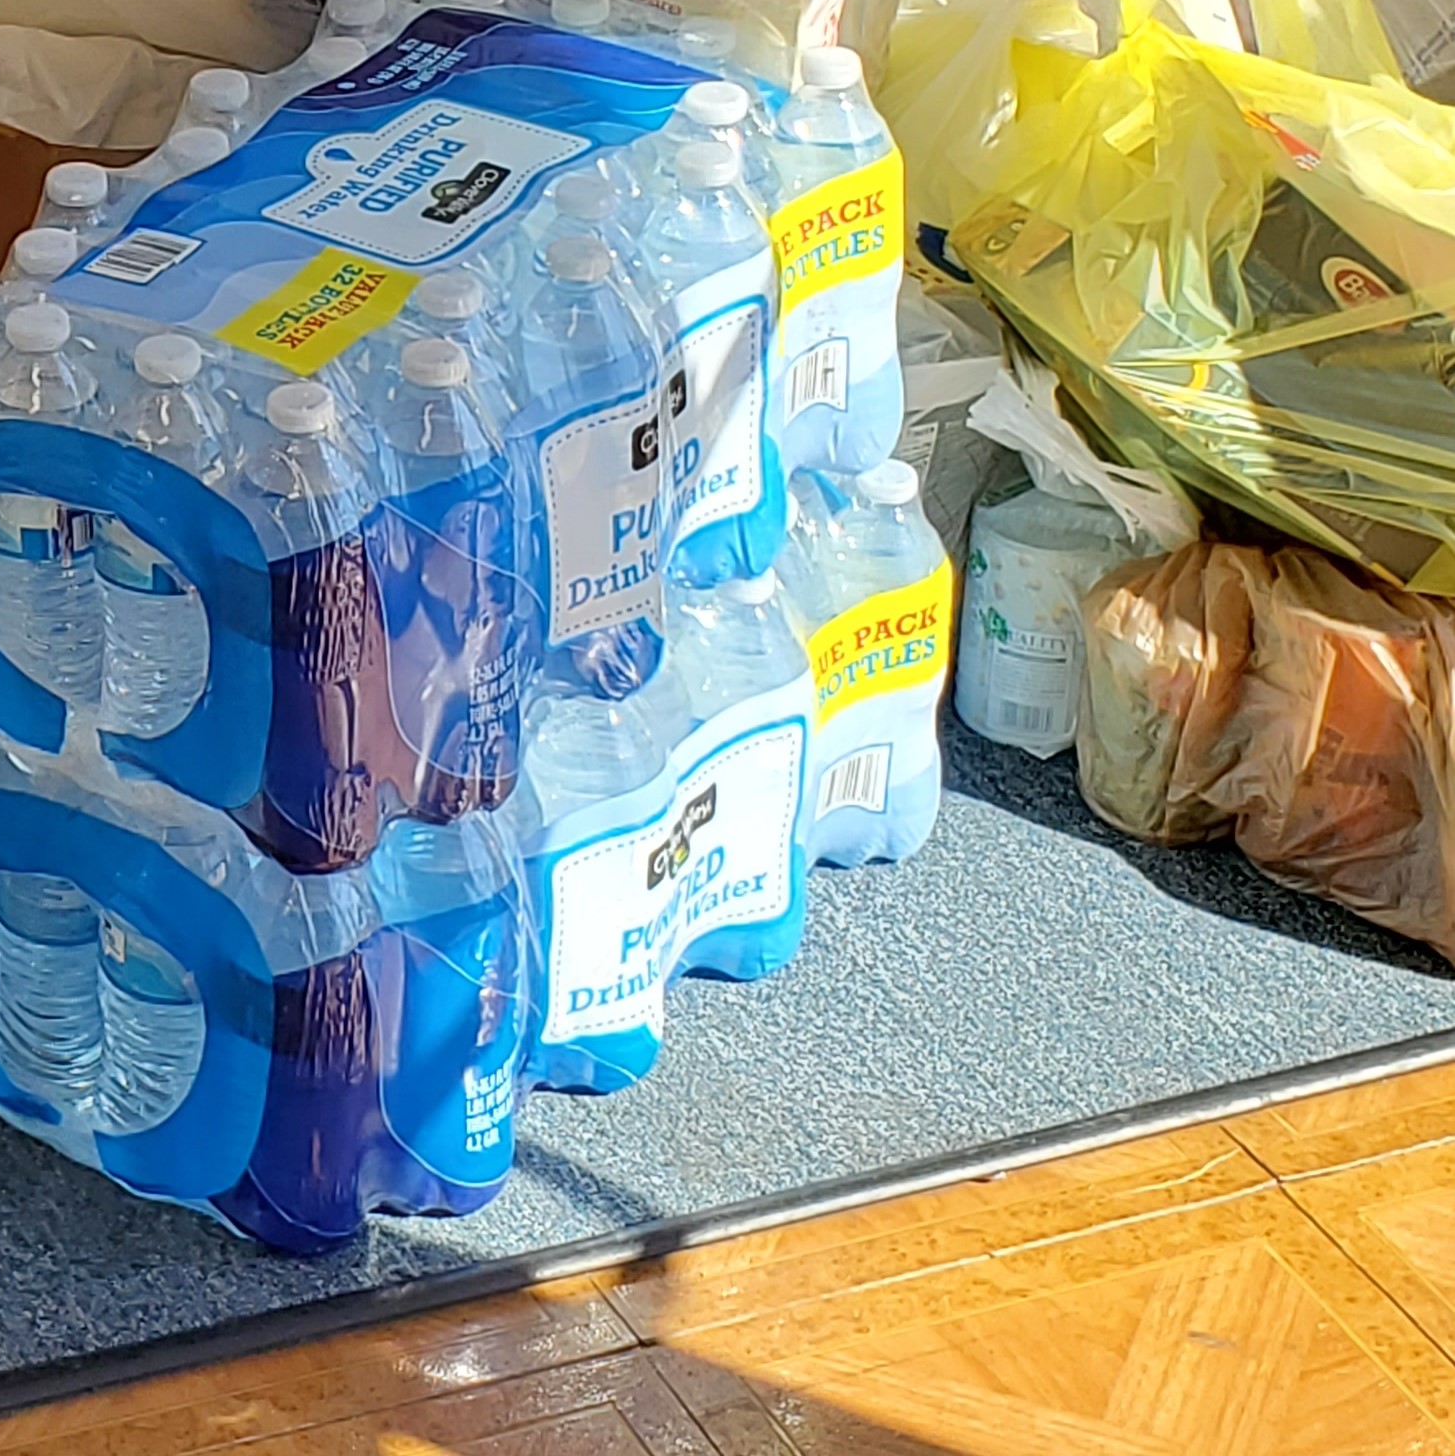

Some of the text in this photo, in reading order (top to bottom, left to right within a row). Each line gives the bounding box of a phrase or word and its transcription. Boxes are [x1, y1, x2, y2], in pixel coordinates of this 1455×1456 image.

[298, 111, 461, 221] Drinking Water
[358, 138, 467, 215] PURIFIED
[798, 189, 885, 244] PACK
[340, 261, 367, 285] 32
[782, 224, 885, 290] OTTLES
[567, 549, 658, 611] Drink
[854, 604, 938, 653] PACK
[1008, 630, 1067, 653] UALITY
[683, 872, 768, 930] Water
